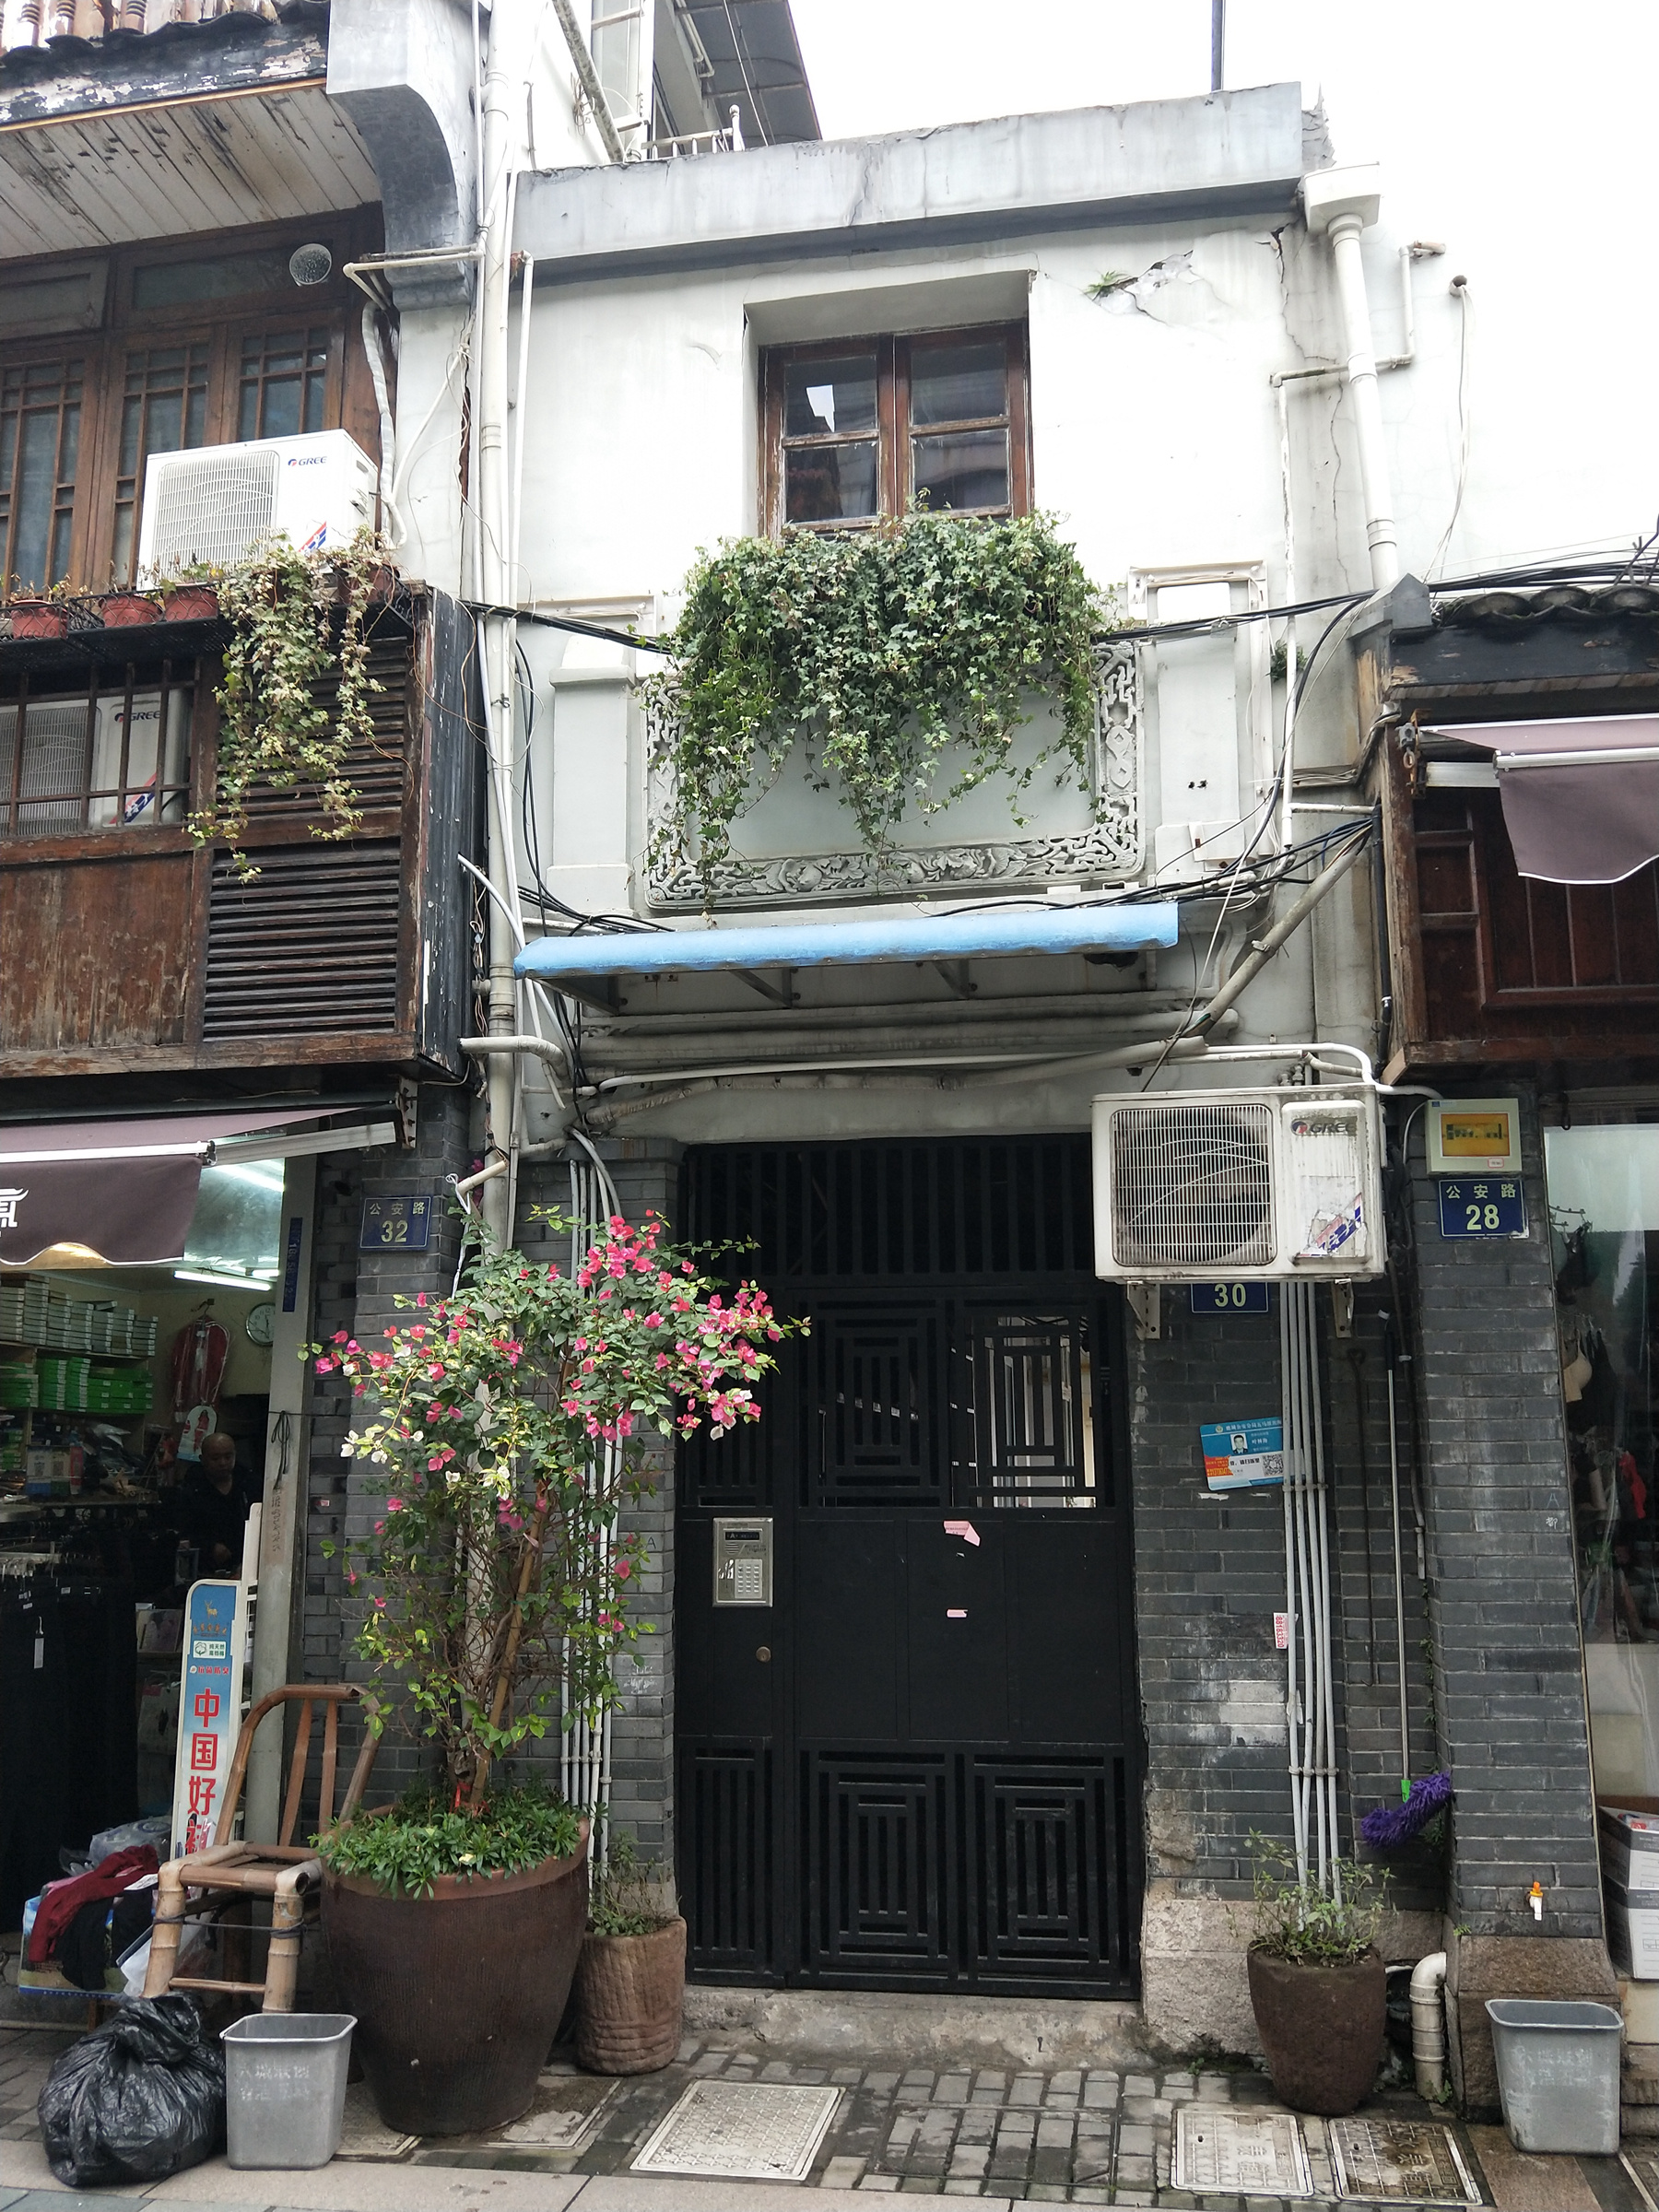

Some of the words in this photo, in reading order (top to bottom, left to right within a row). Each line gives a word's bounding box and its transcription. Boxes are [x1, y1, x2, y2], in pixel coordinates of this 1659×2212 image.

[299, 456, 327, 466] GREE
[1310, 1122, 1357, 1134] GREE
[1446, 1183, 1516, 1199] 公安路
[370, 1201, 425, 1215] 公安路
[1465, 1204, 1500, 1230] 28
[381, 1219, 408, 1242] 32
[1214, 1283, 1246, 1307] 30
